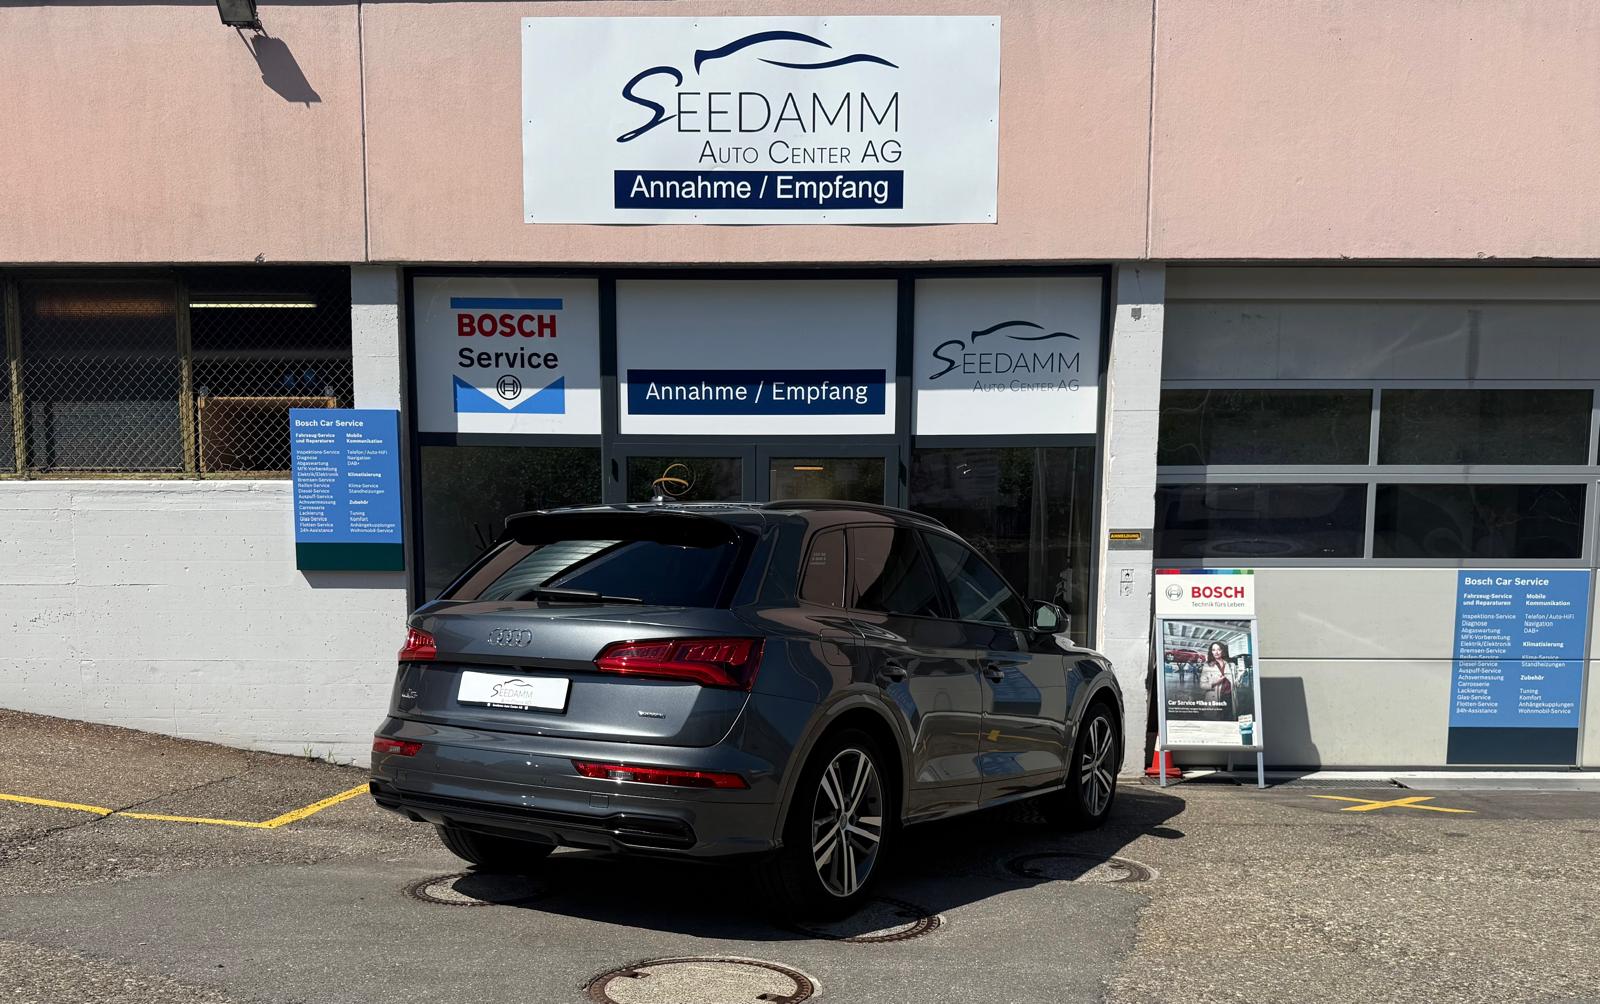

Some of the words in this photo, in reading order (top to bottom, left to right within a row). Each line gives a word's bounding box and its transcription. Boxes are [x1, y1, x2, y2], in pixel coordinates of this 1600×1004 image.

[615, 65, 900, 142] SEEDAMM
[698, 141, 759, 164] AUTO
[769, 141, 850, 164] CENTER
[860, 141, 902, 164] AG
[630, 174, 751, 199] Annahme
[759, 175, 768, 199] /
[776, 175, 889, 205] Empfang
[457, 313, 557, 338] BOSCH
[458, 347, 559, 369] Service
[929, 339, 1080, 379] SEEDAMM
[646, 381, 747, 400] Annahme
[754, 381, 764, 403] /
[772, 381, 868, 404] Empfang
[973, 380, 1005, 392] AUTO
[1009, 379, 1053, 392] CENTER
[1056, 379, 1079, 392] AG
[1191, 586, 1244, 598] BOSCH
[1464, 577, 1492, 586] Bosch
[1495, 577, 1512, 586] Car
[1514, 577, 1549, 586] Service
